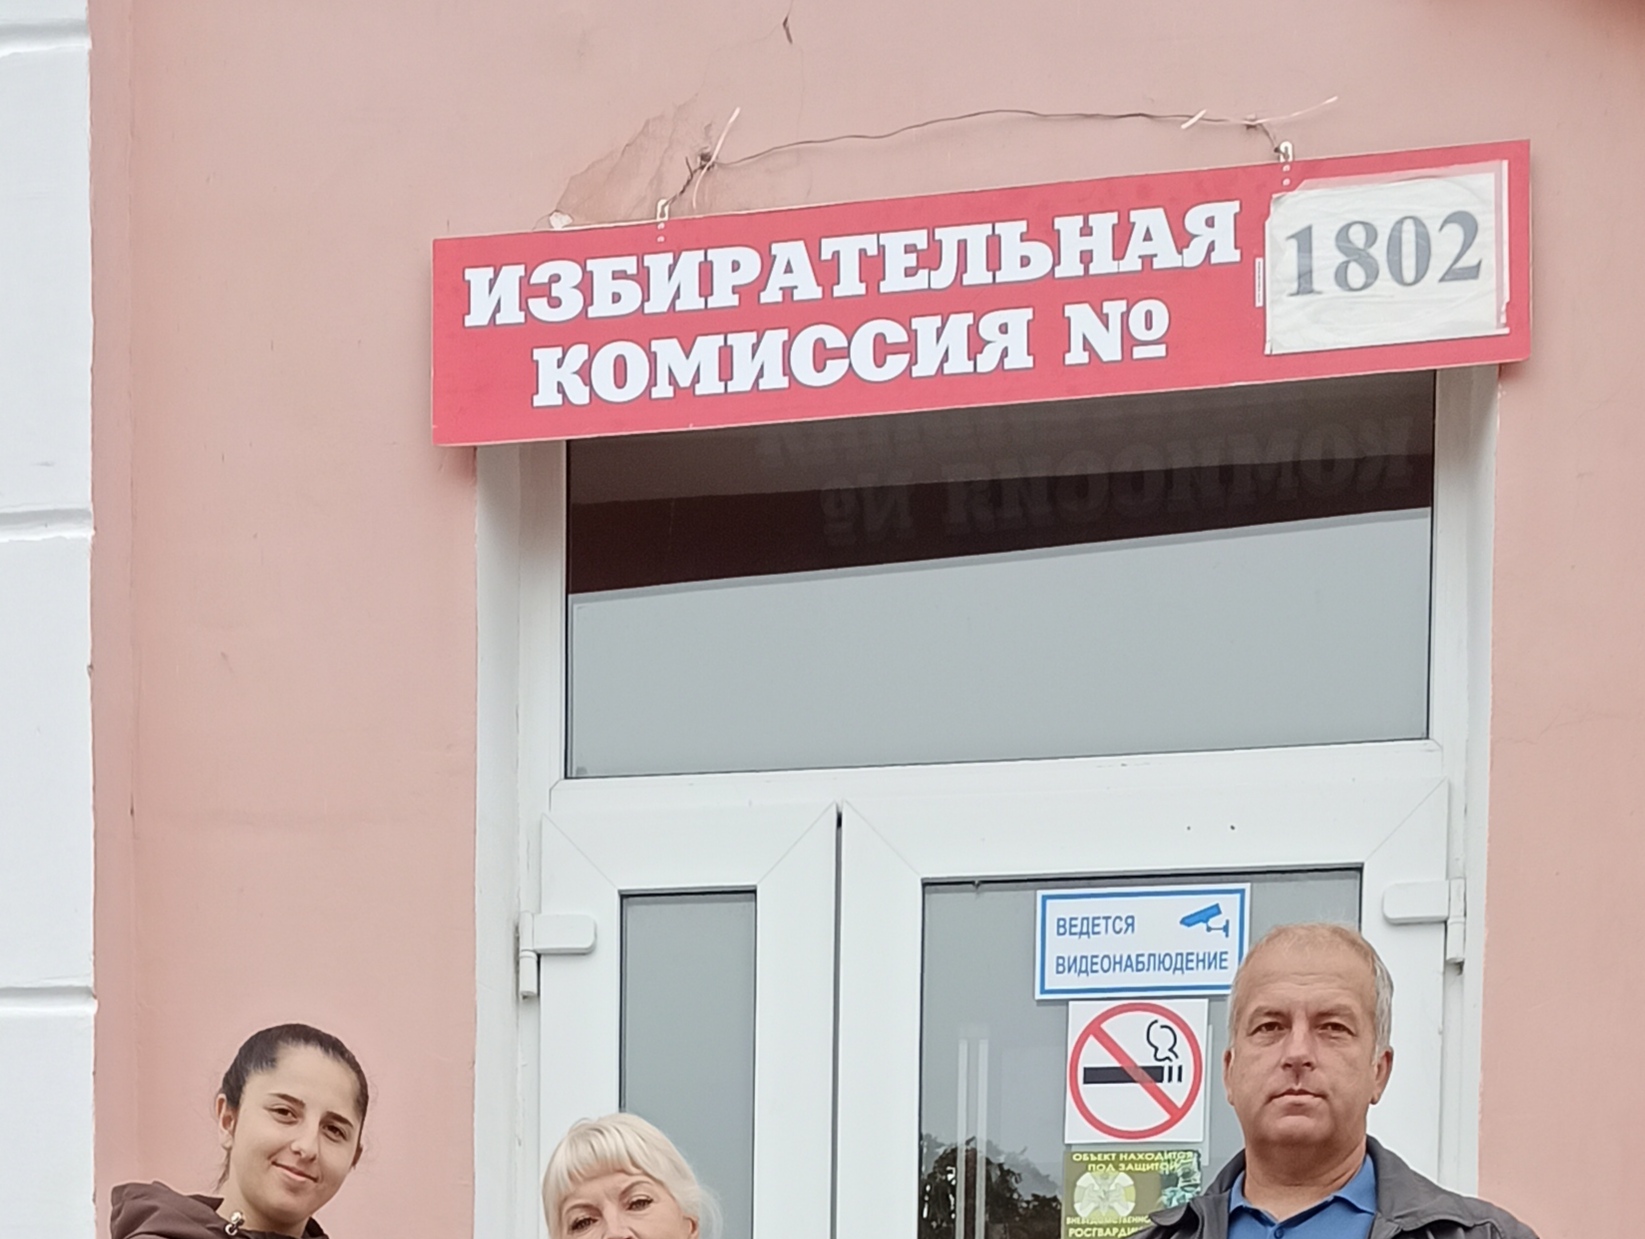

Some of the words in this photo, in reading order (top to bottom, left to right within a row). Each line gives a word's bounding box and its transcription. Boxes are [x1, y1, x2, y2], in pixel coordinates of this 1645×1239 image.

[464, 199, 1241, 327] ИЗБИРАТЕЛЬНАЯ
[1286, 210, 1483, 298] 1802
[532, 308, 1034, 408] КОМИССИЯ
[1064, 299, 1170, 366] №
[1056, 915, 1135, 939] ВЕДЕТСЯ
[1055, 951, 1229, 977] ВИДЕОНАБЛЮДЕНИЕ
[1072, 1152, 1116, 1162] ОБЪЕКТ
